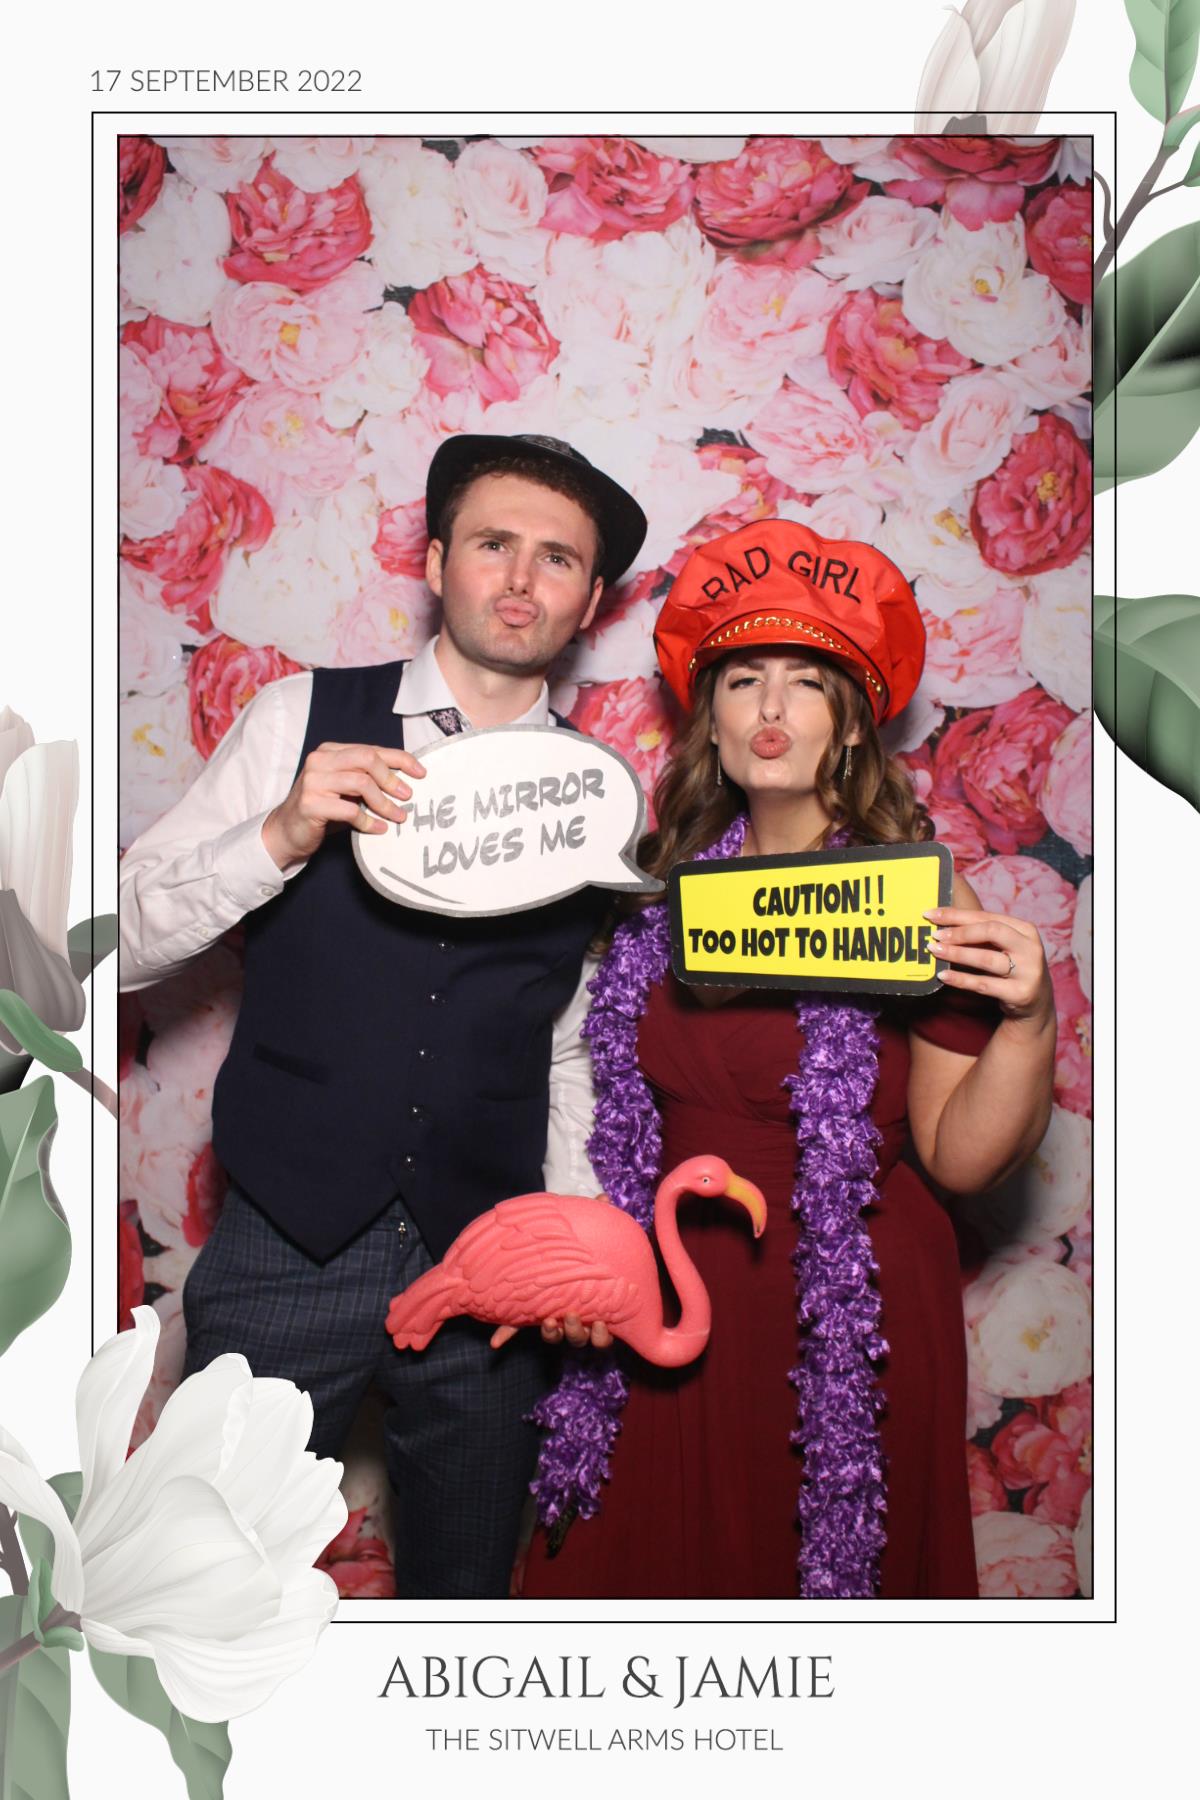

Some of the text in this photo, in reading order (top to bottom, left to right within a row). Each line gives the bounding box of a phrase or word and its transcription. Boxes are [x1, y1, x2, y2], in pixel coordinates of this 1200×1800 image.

[786, 549, 862, 604] GIRL
[473, 767, 606, 823] MIRROR
[422, 814, 587, 879] LOVES ME
[752, 874, 886, 917] CAUTION!!
[688, 925, 932, 965] TOO HOT TO HANDLE
